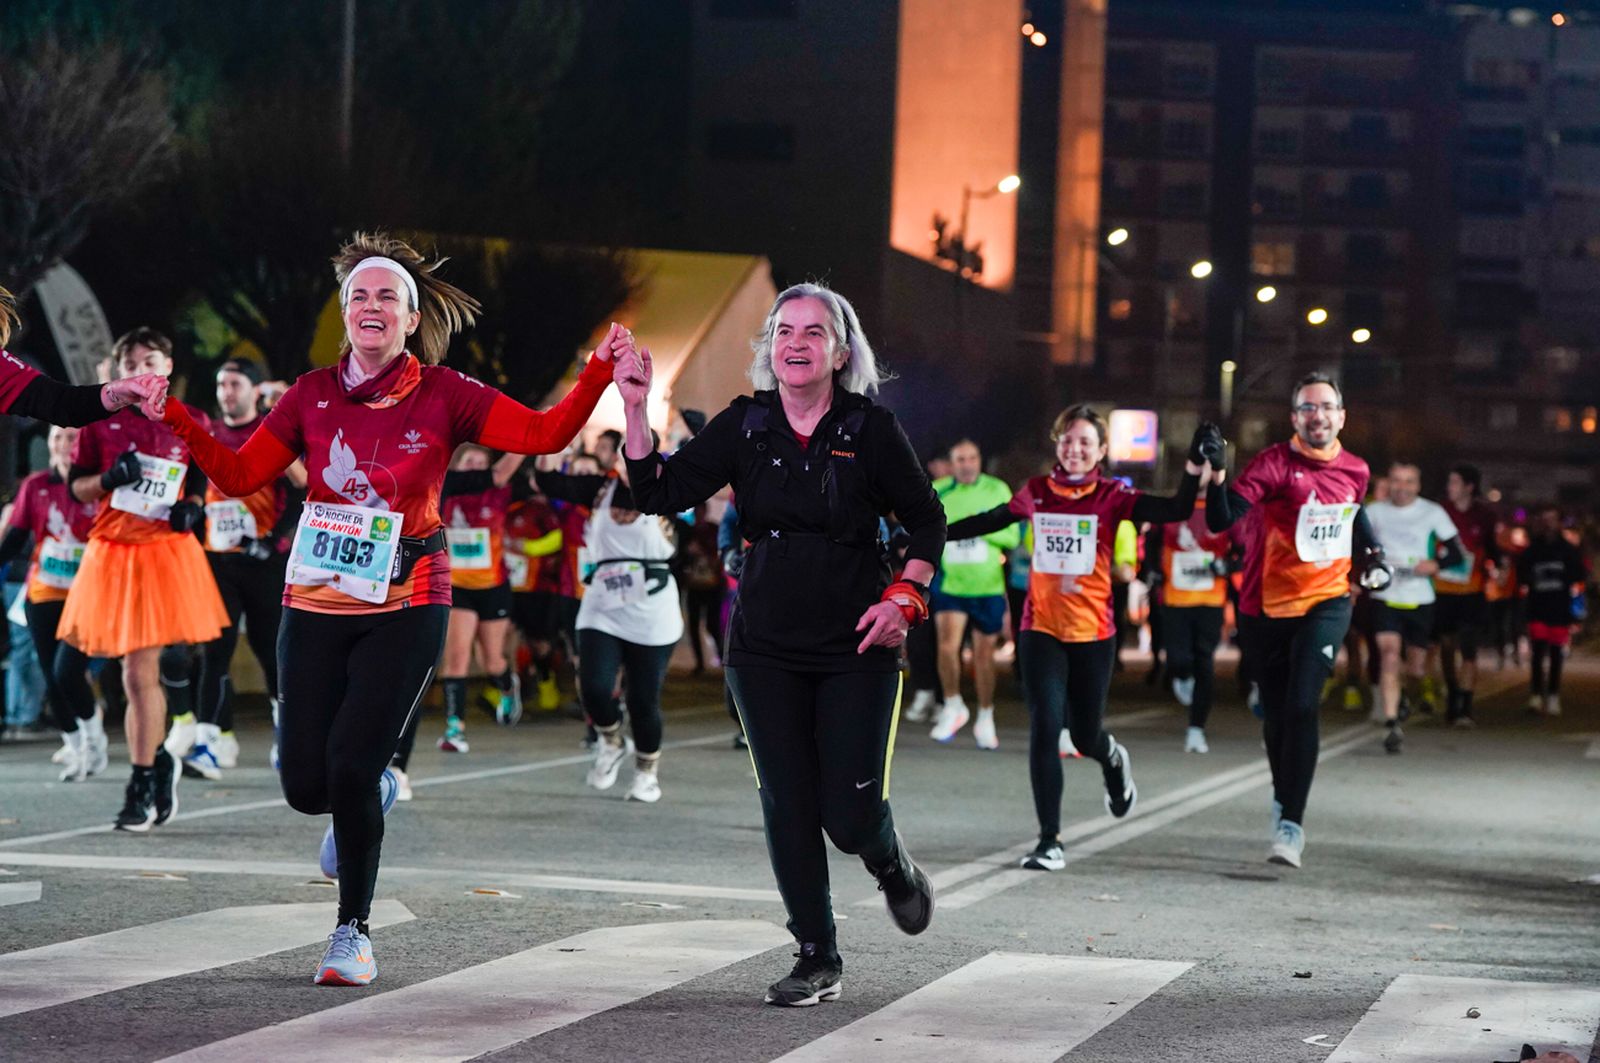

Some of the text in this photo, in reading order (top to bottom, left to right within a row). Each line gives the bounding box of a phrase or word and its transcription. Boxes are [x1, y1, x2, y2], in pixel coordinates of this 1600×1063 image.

[133, 478, 167, 497] 2713
[341, 477, 369, 501] 43
[309, 518, 328, 530] SAN
[329, 522, 363, 537] ANTÓN
[325, 510, 353, 524] NOCHE
[353, 515, 364, 526] DE
[312, 531, 376, 568] 8193
[1046, 535, 1082, 554] 5521
